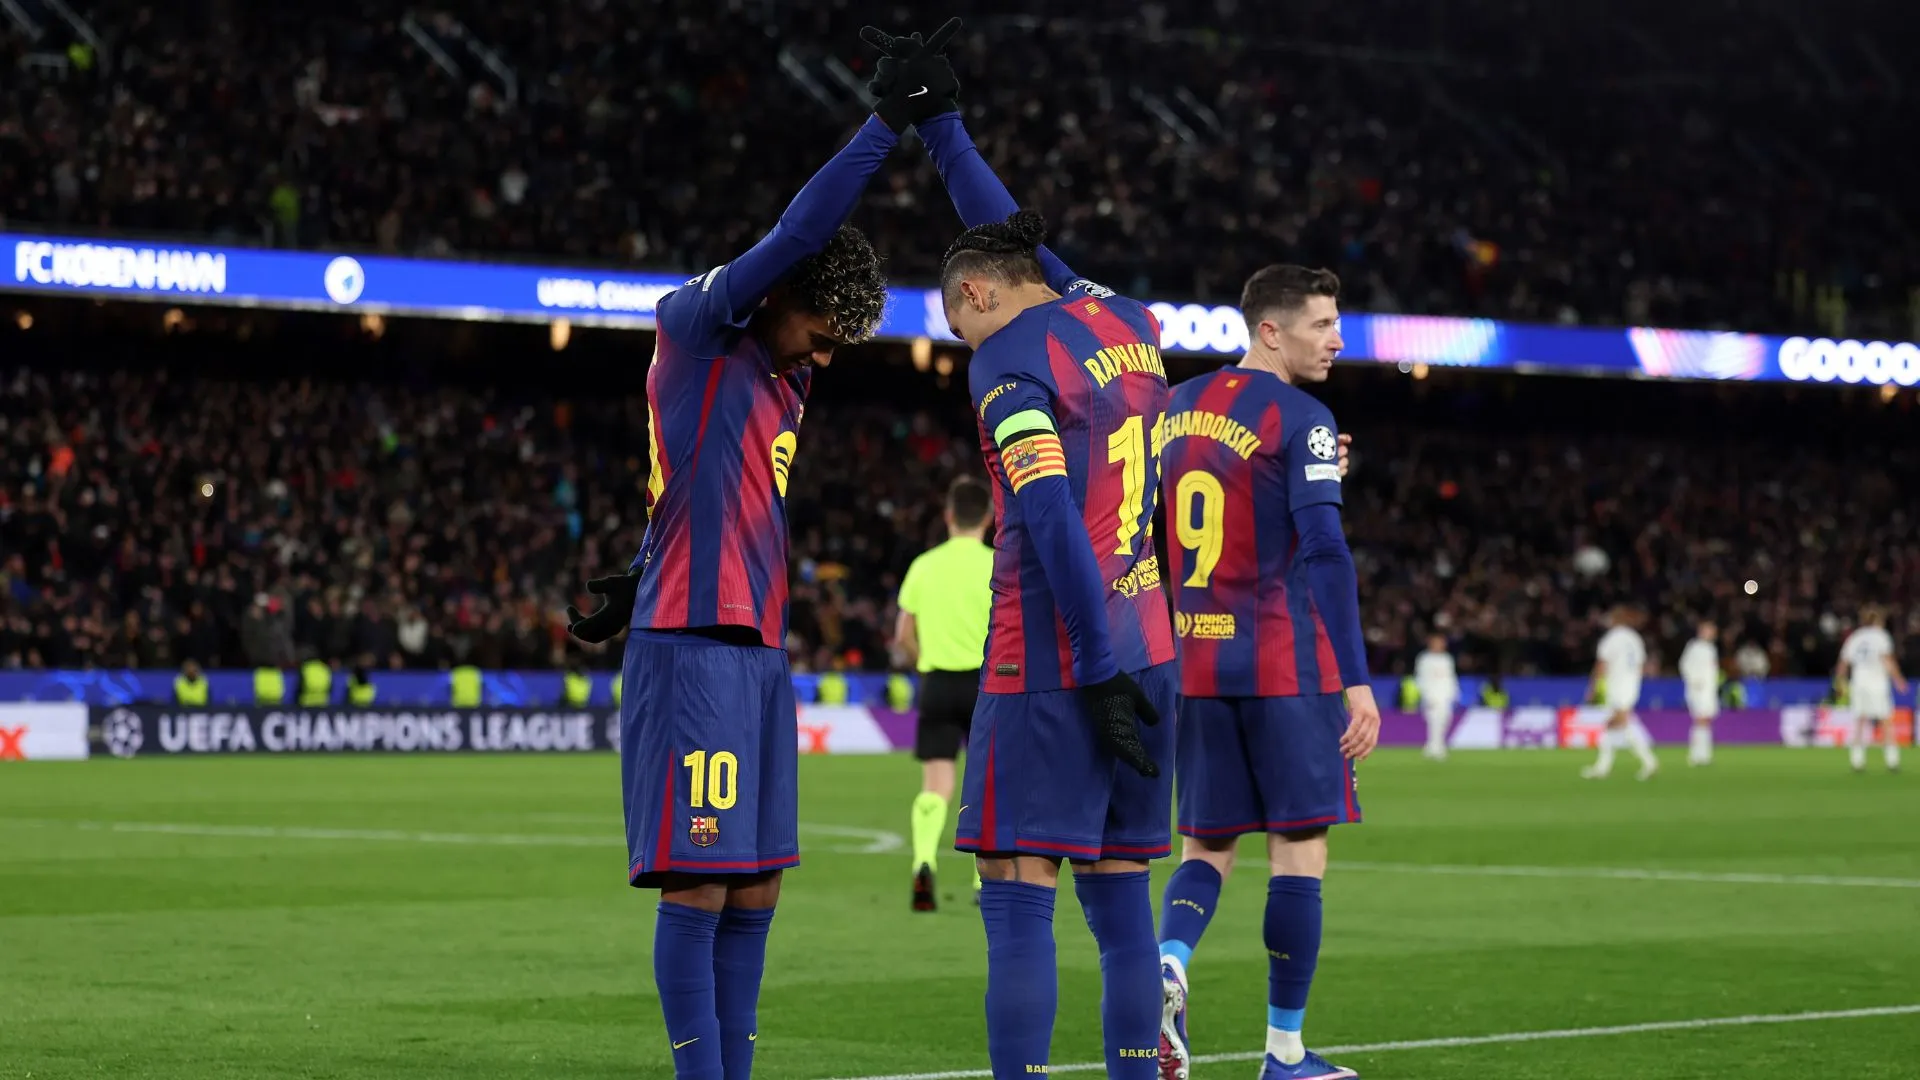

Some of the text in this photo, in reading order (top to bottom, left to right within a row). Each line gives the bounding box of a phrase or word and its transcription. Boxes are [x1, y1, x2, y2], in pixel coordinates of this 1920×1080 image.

[1084, 343, 1167, 389] RAPHINH
[1176, 470, 1225, 587] 9
[1192, 625, 1236, 635] ACNUR
[1194, 614, 1235, 625] UNHCR
[158, 711, 594, 751] UEFA CHAMPIONS LEAGUE
[684, 751, 738, 810] 10
[1119, 1048, 1158, 1059] BARÇA
